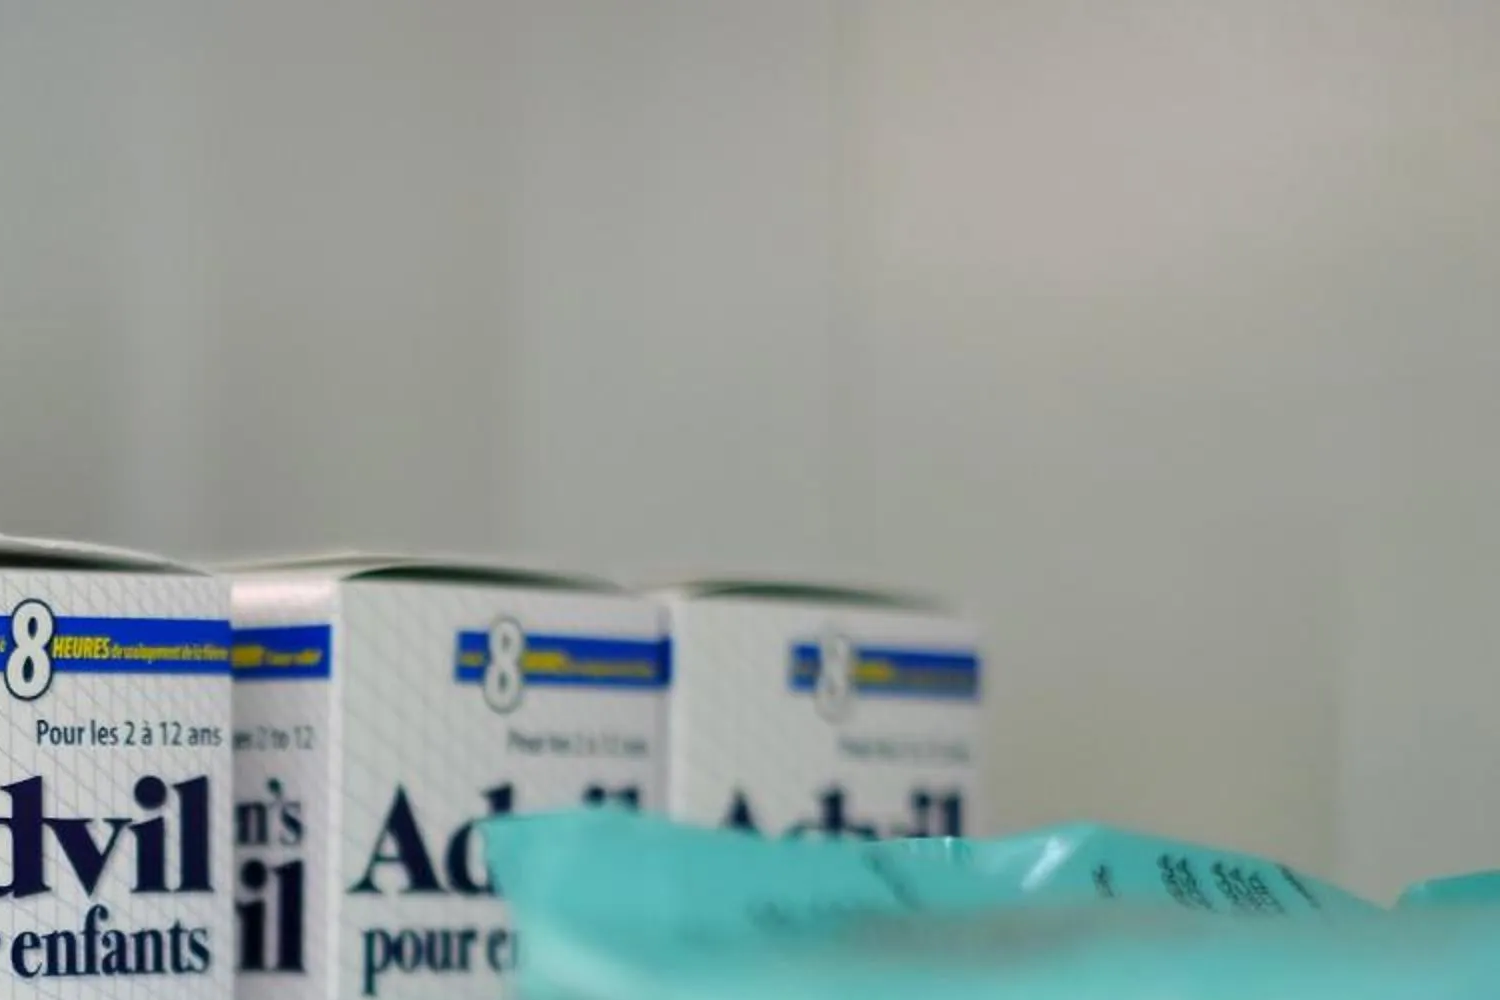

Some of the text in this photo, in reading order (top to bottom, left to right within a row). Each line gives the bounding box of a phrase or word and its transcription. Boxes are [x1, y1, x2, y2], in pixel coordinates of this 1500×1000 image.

[4, 598, 54, 701] 8
[53, 636, 112, 660] HEURES
[483, 615, 525, 715] 8
[37, 719, 222, 747] Pour les 2 à 12 ans
[11, 903, 212, 977] enfants
[362, 926, 479, 998] pour
